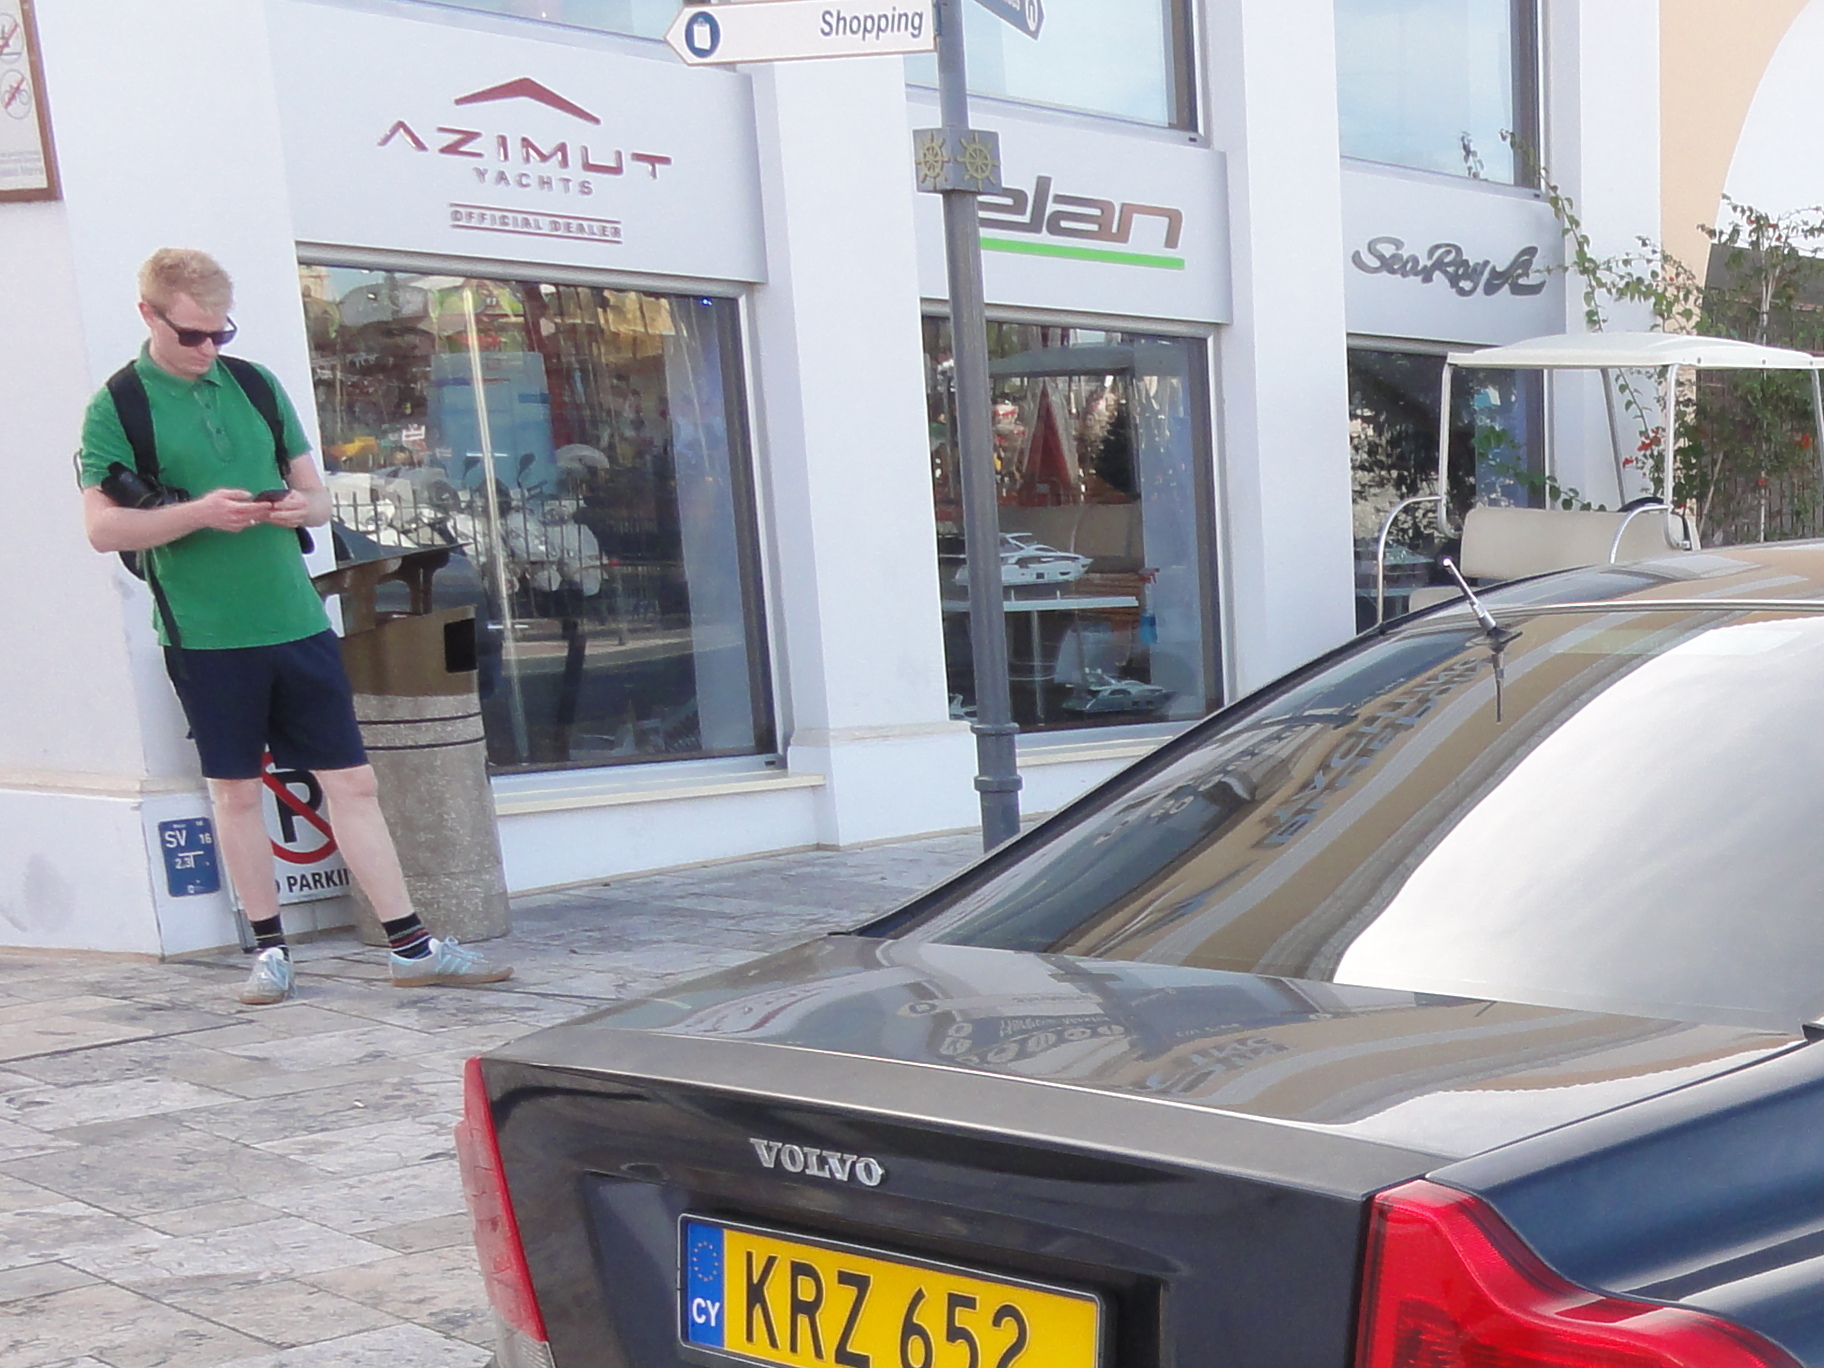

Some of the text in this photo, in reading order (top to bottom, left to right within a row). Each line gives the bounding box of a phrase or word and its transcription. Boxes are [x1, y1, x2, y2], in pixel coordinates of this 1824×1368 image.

[820, 7, 924, 41] Shopping
[377, 120, 672, 179] AZIMUT
[472, 166, 594, 196] YACHTS
[450, 209, 622, 238] OFFICIAL DEALER
[976, 175, 1183, 249] elan
[165, 830, 187, 848] SV
[286, 868, 350, 893] PARKI
[749, 1138, 885, 1187] VOLVO
[692, 1297, 720, 1327] CY
